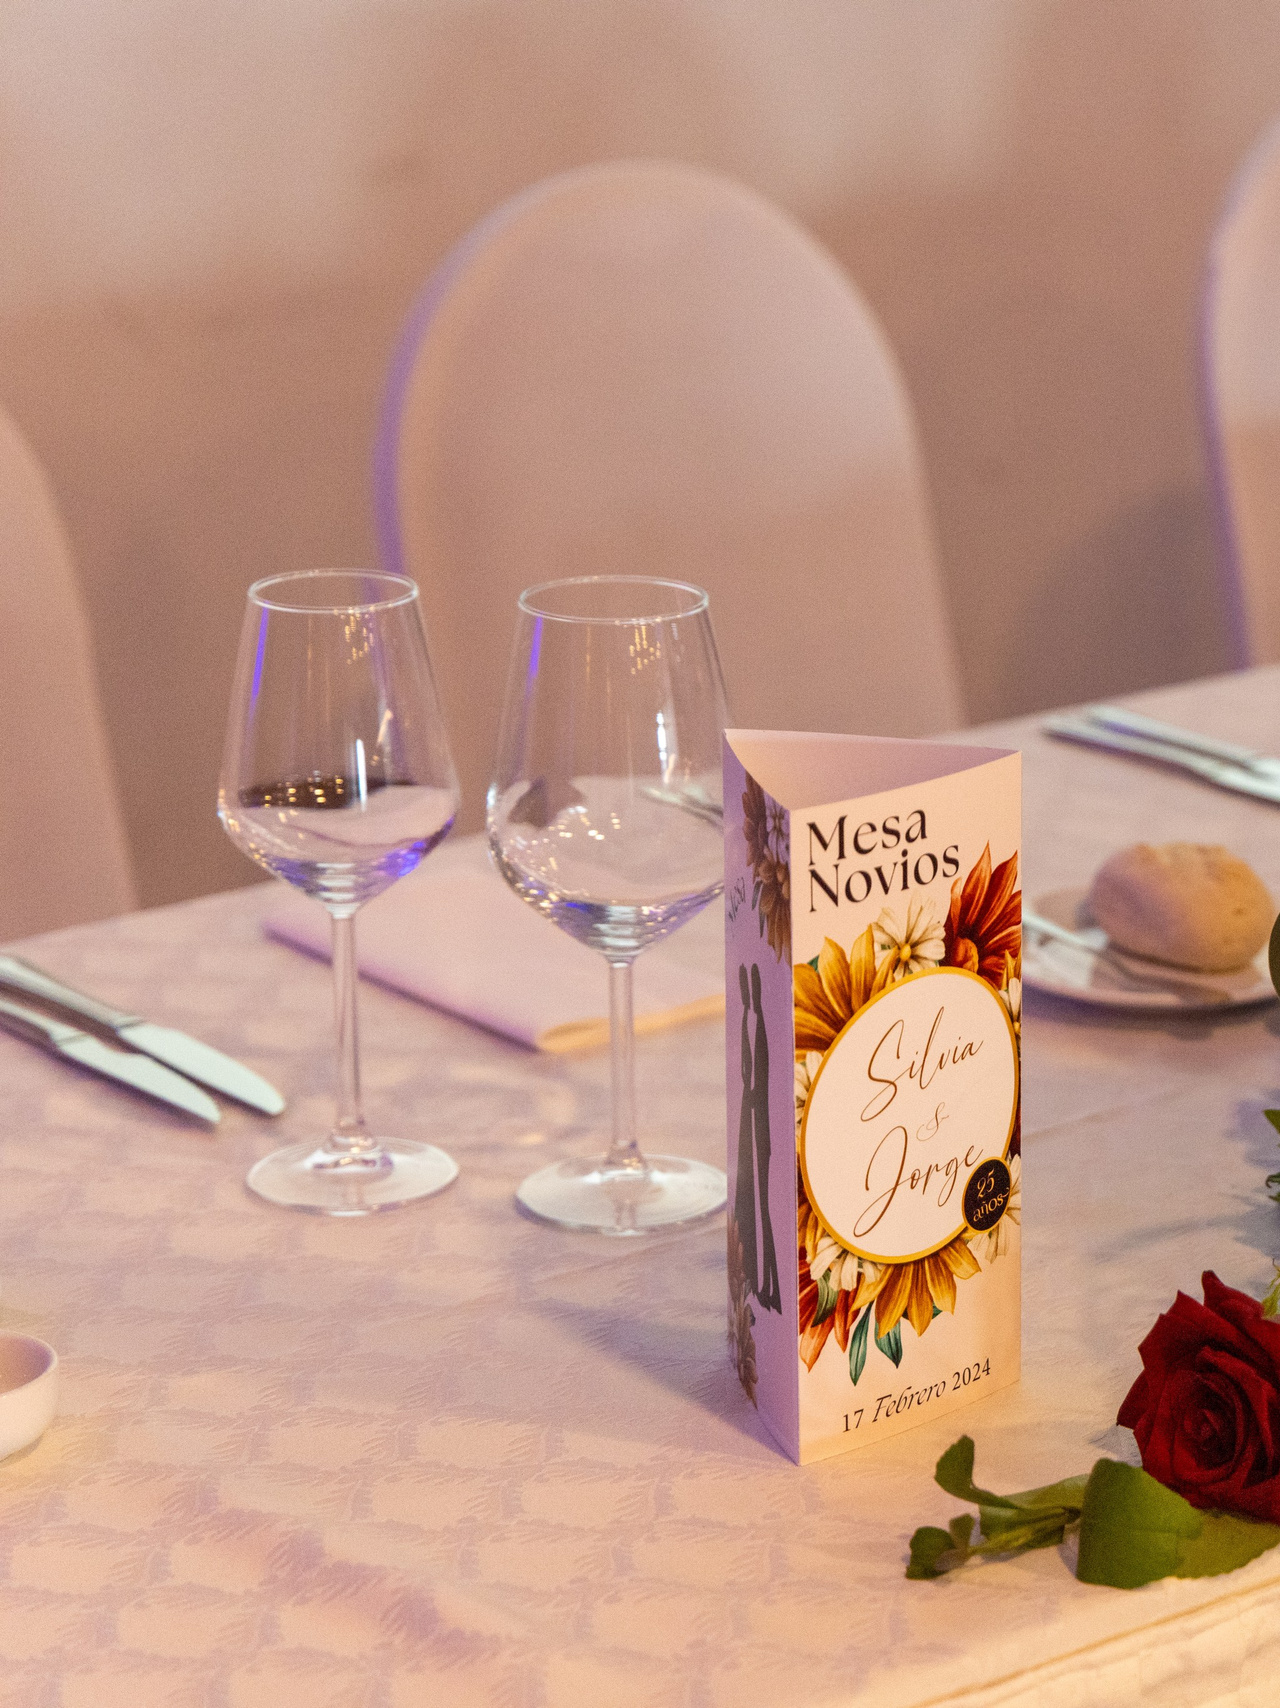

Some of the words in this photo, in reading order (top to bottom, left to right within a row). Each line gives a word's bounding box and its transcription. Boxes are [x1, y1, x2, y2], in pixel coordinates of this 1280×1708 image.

[806, 809, 928, 866] Mesa
[808, 844, 960, 913] Novios
[860, 1006, 984, 1122] Silvia
[916, 1102, 949, 1141] &
[853, 1125, 984, 1238] Jorge
[973, 1187, 1010, 1222] años
[977, 1167, 995, 1200] 25
[842, 1408, 864, 1433] 17
[872, 1380, 946, 1423] Febrero
[952, 1357, 991, 1391] 2024
